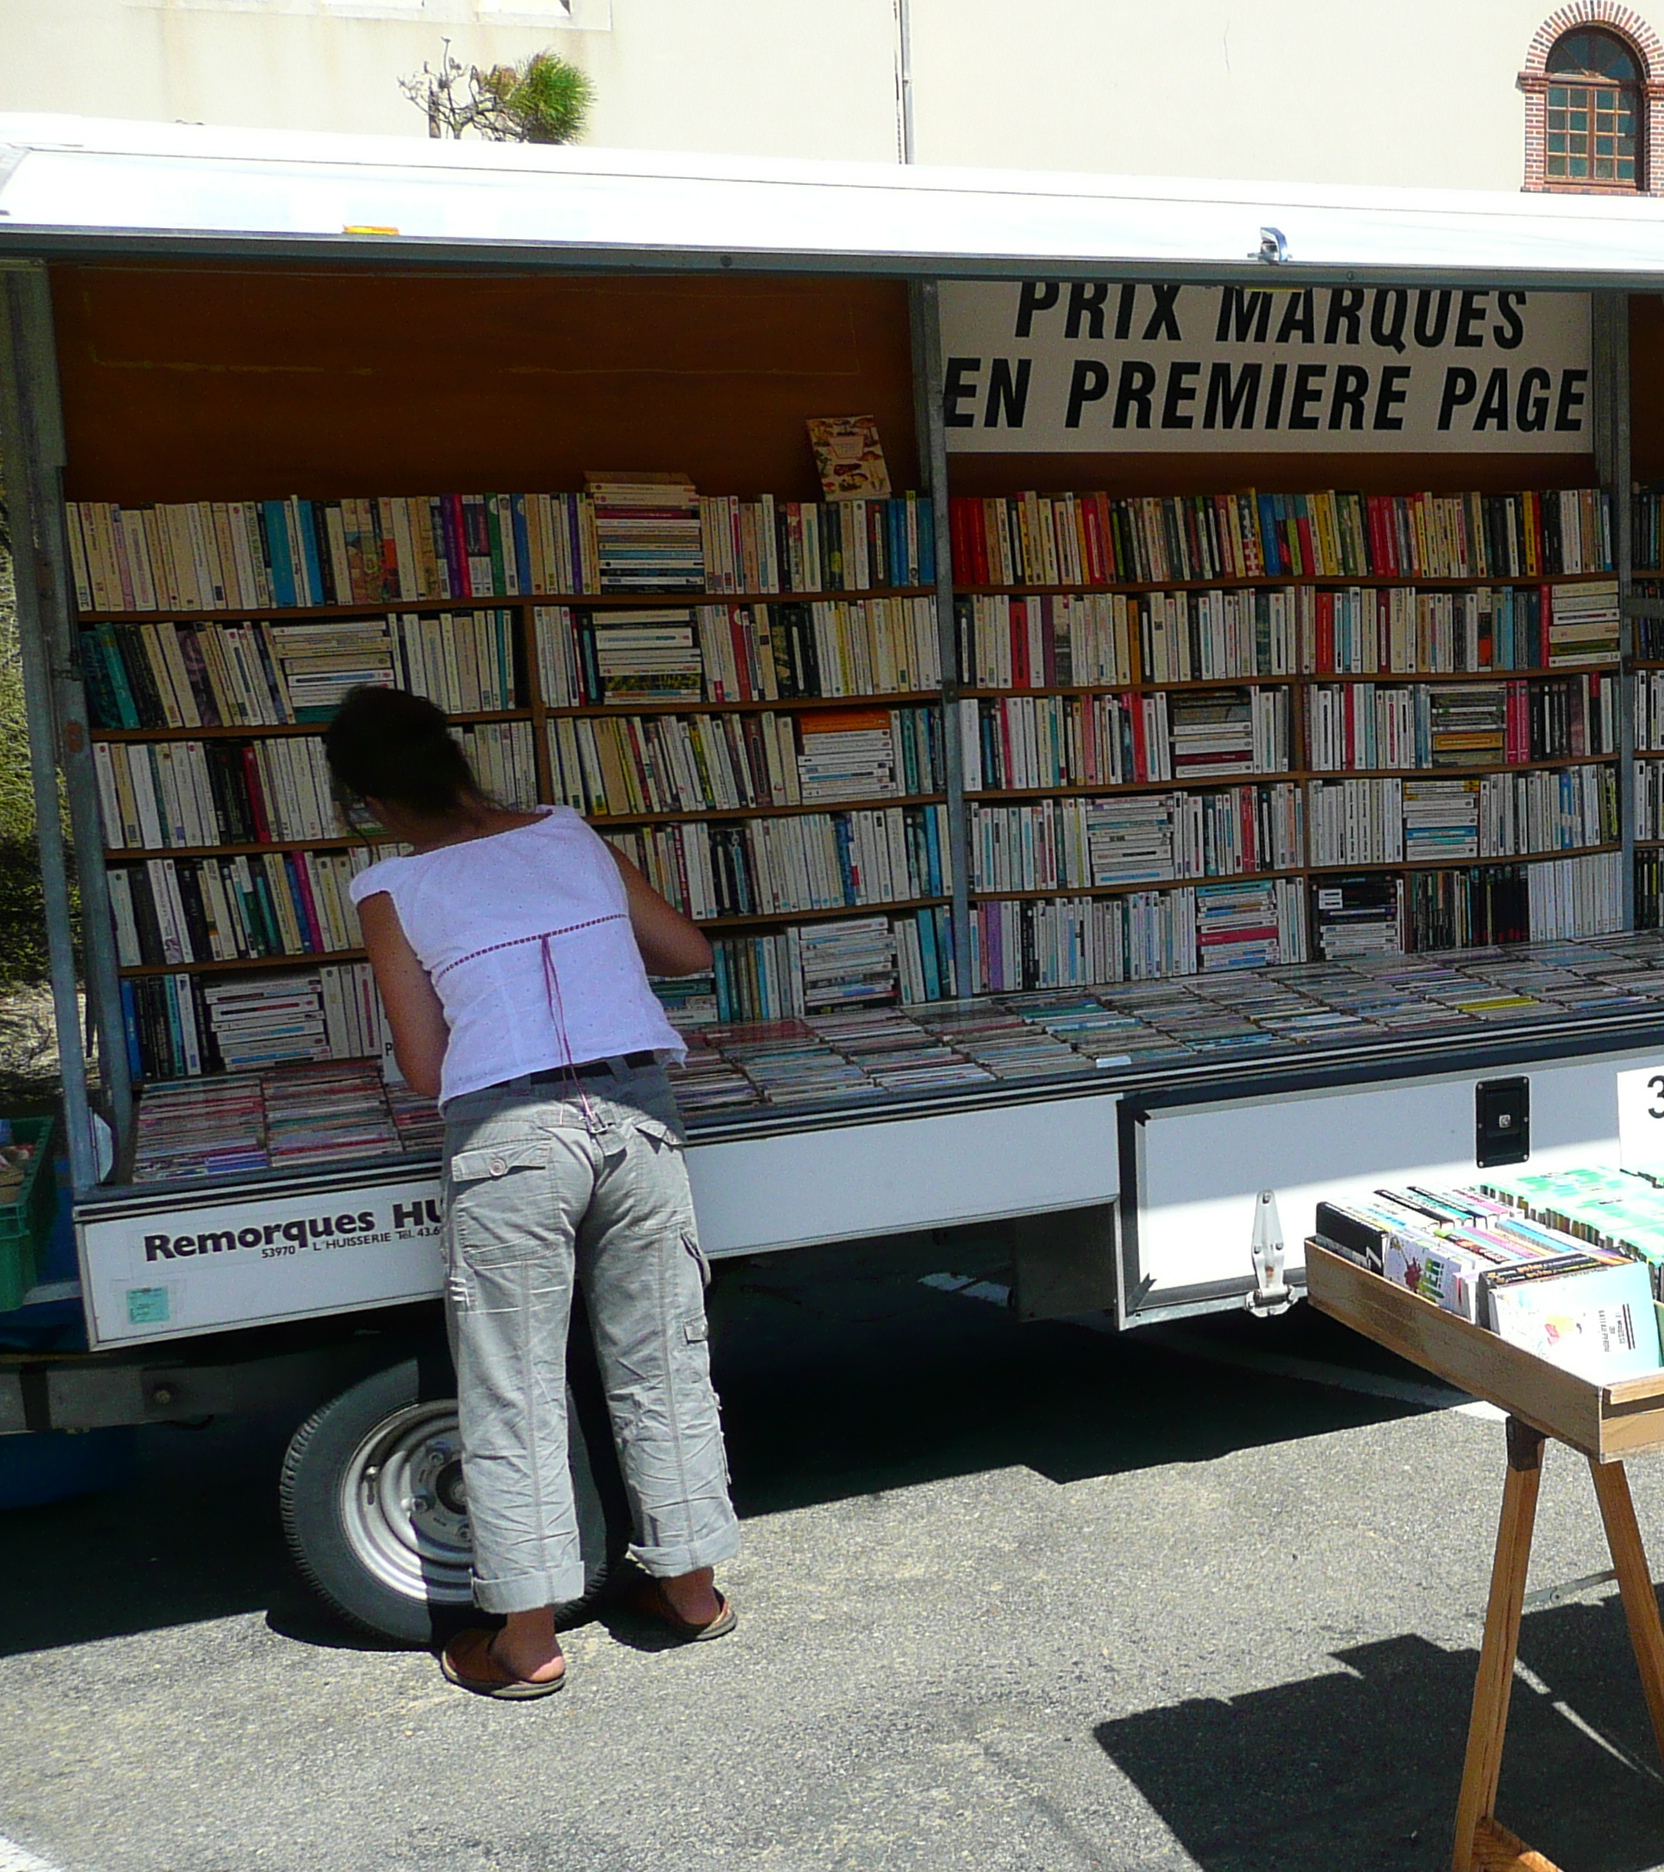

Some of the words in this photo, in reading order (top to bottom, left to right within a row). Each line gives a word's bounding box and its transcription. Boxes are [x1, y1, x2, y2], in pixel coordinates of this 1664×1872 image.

[1013, 283, 1182, 341] PRIX
[1215, 287, 1528, 355] MARQUES
[944, 357, 1032, 429] EN
[1064, 361, 1411, 432] PREMIERE
[1437, 366, 1589, 433] PAGE
[144, 1210, 375, 1262] Remorques
[262, 1245, 296, 1259] 53970
